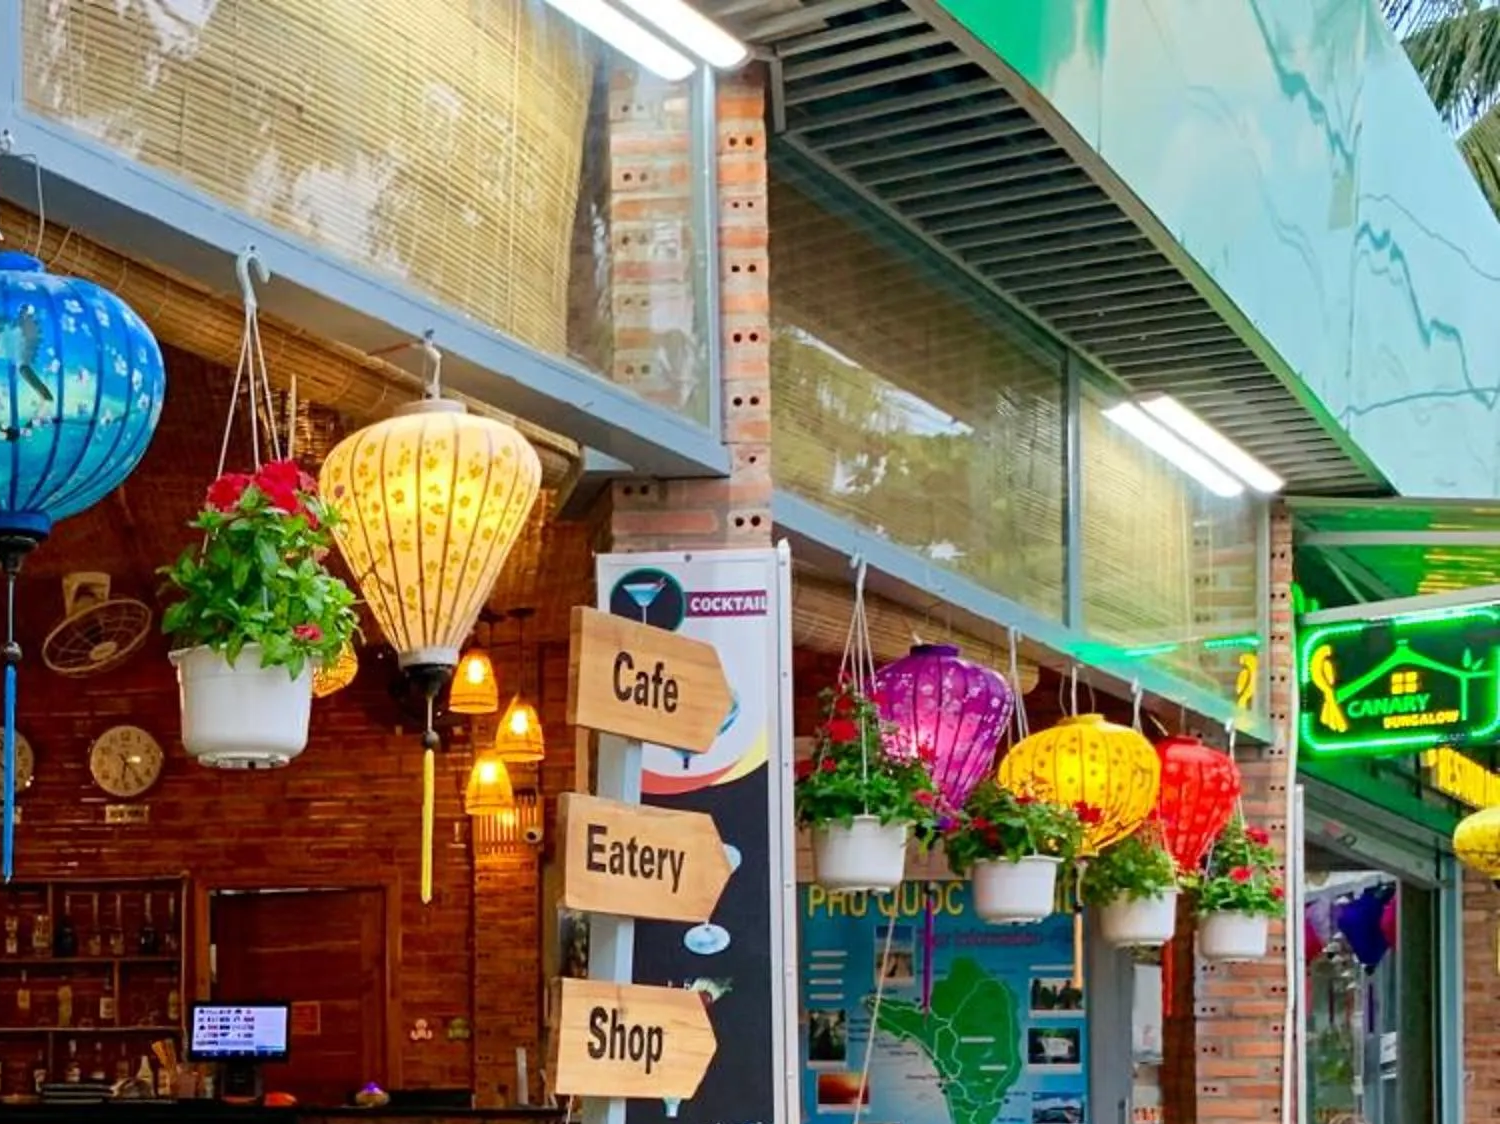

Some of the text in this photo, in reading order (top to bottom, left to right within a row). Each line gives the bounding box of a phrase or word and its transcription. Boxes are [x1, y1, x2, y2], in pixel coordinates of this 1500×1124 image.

[690, 595, 767, 612] COCKTAIL
[613, 651, 679, 713] Cafe
[1347, 693, 1431, 719] CANARY
[1383, 709, 1459, 729] BUNGALOW
[586, 823, 685, 894] Eatery
[587, 1005, 663, 1075] Shop
